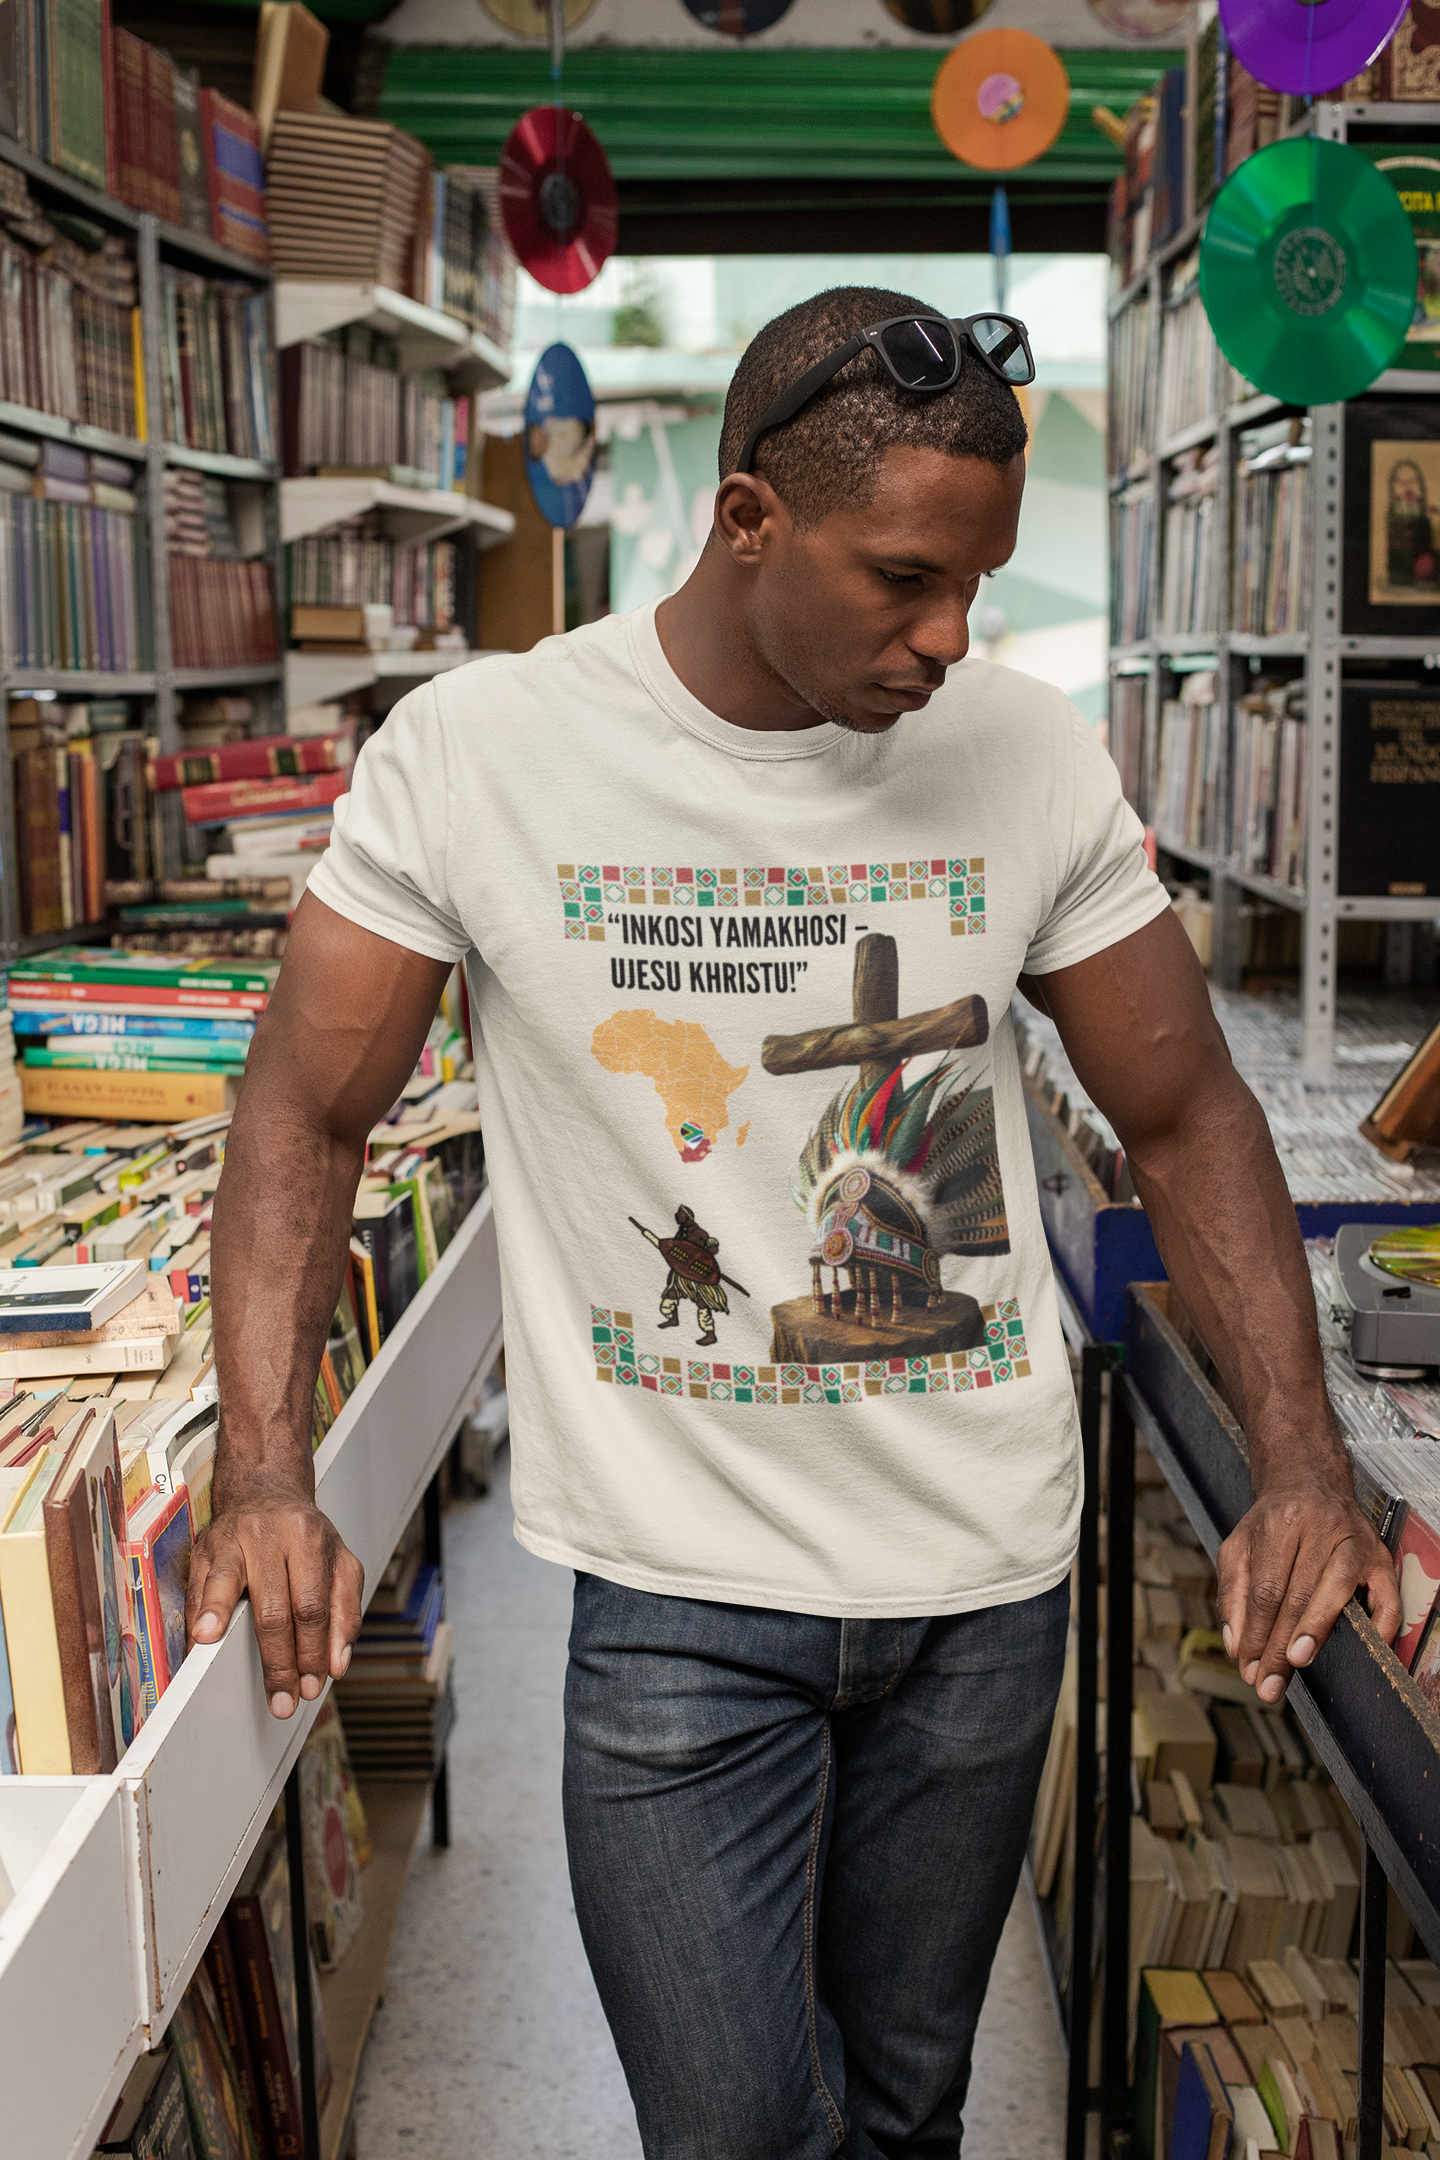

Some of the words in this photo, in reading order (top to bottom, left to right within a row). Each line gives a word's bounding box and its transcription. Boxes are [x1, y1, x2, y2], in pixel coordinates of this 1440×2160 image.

[608, 913, 703, 947] “INKOSI
[709, 914, 846, 948] YAMAKHOSI
[611, 957, 681, 992] UJESU
[689, 961, 808, 994] KHRISTU!”
[71, 1013, 126, 1034] MEGA
[94, 1055, 148, 1071] MEGA
